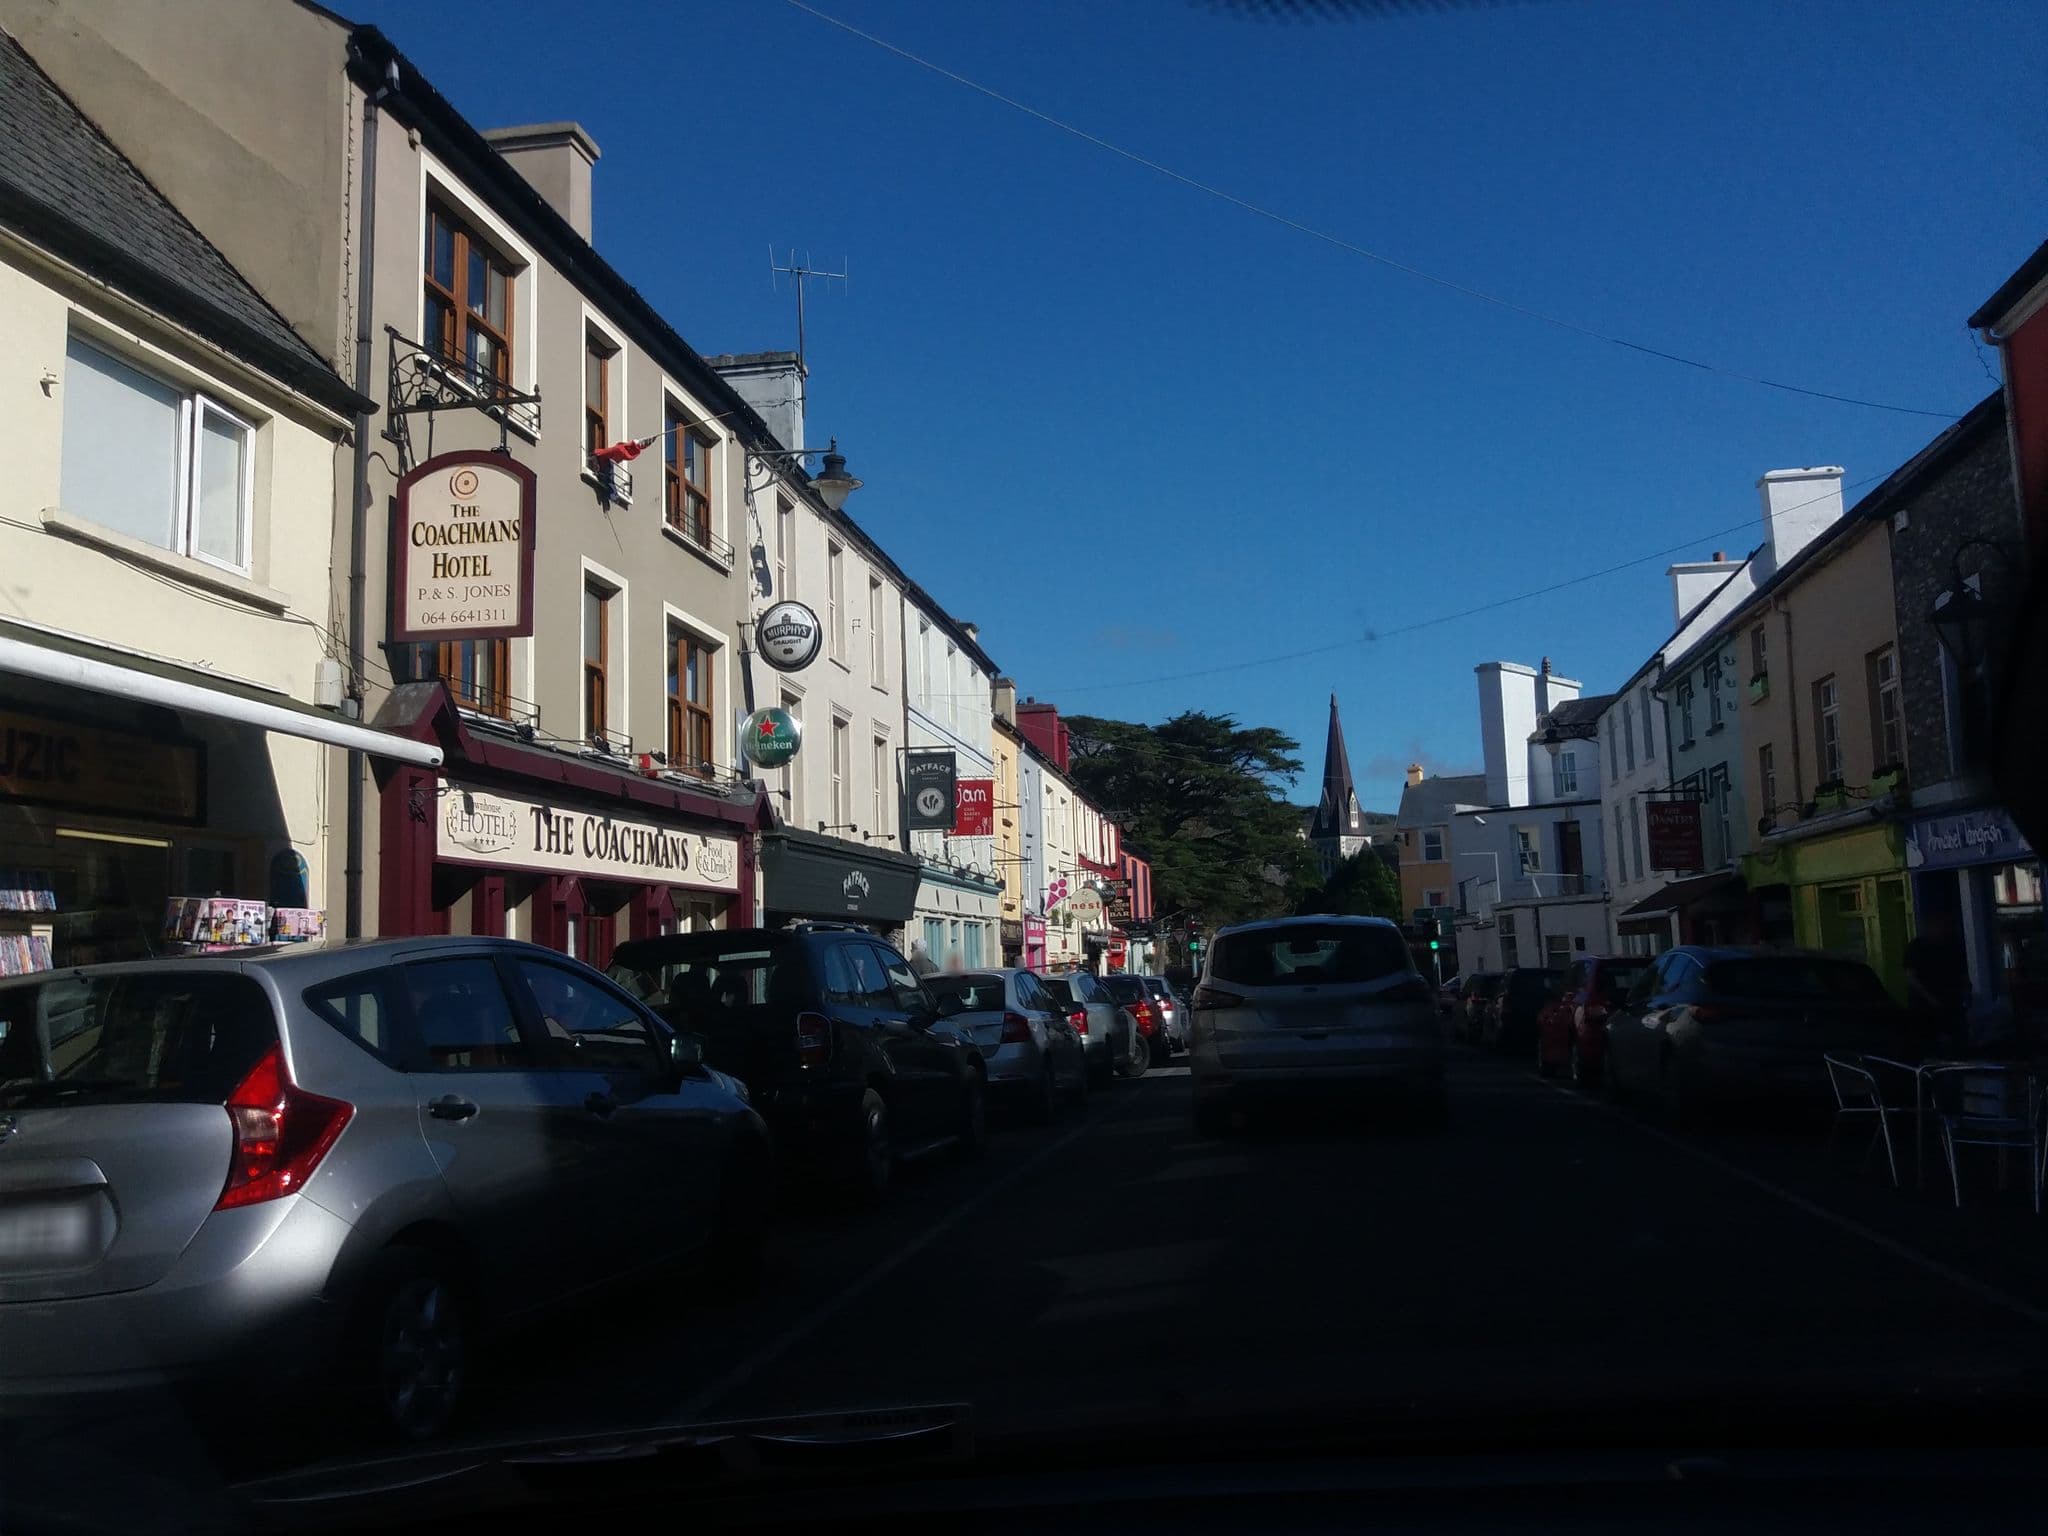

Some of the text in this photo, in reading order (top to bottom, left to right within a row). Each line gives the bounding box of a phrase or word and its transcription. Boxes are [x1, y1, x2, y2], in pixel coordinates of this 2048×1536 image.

[451, 504, 480, 518] THE
[411, 519, 520, 547] COACHMANS
[432, 552, 492, 579] HOTEL
[462, 584, 511, 602] JONES
[422, 608, 506, 625] 064 6641311
[910, 763, 951, 776] FATFACE
[955, 784, 986, 808] jam
[460, 810, 508, 837] HOTEL
[530, 806, 689, 871] THE COACHMANS
[702, 855, 710, 872] &
[1071, 901, 1100, 910] nest
